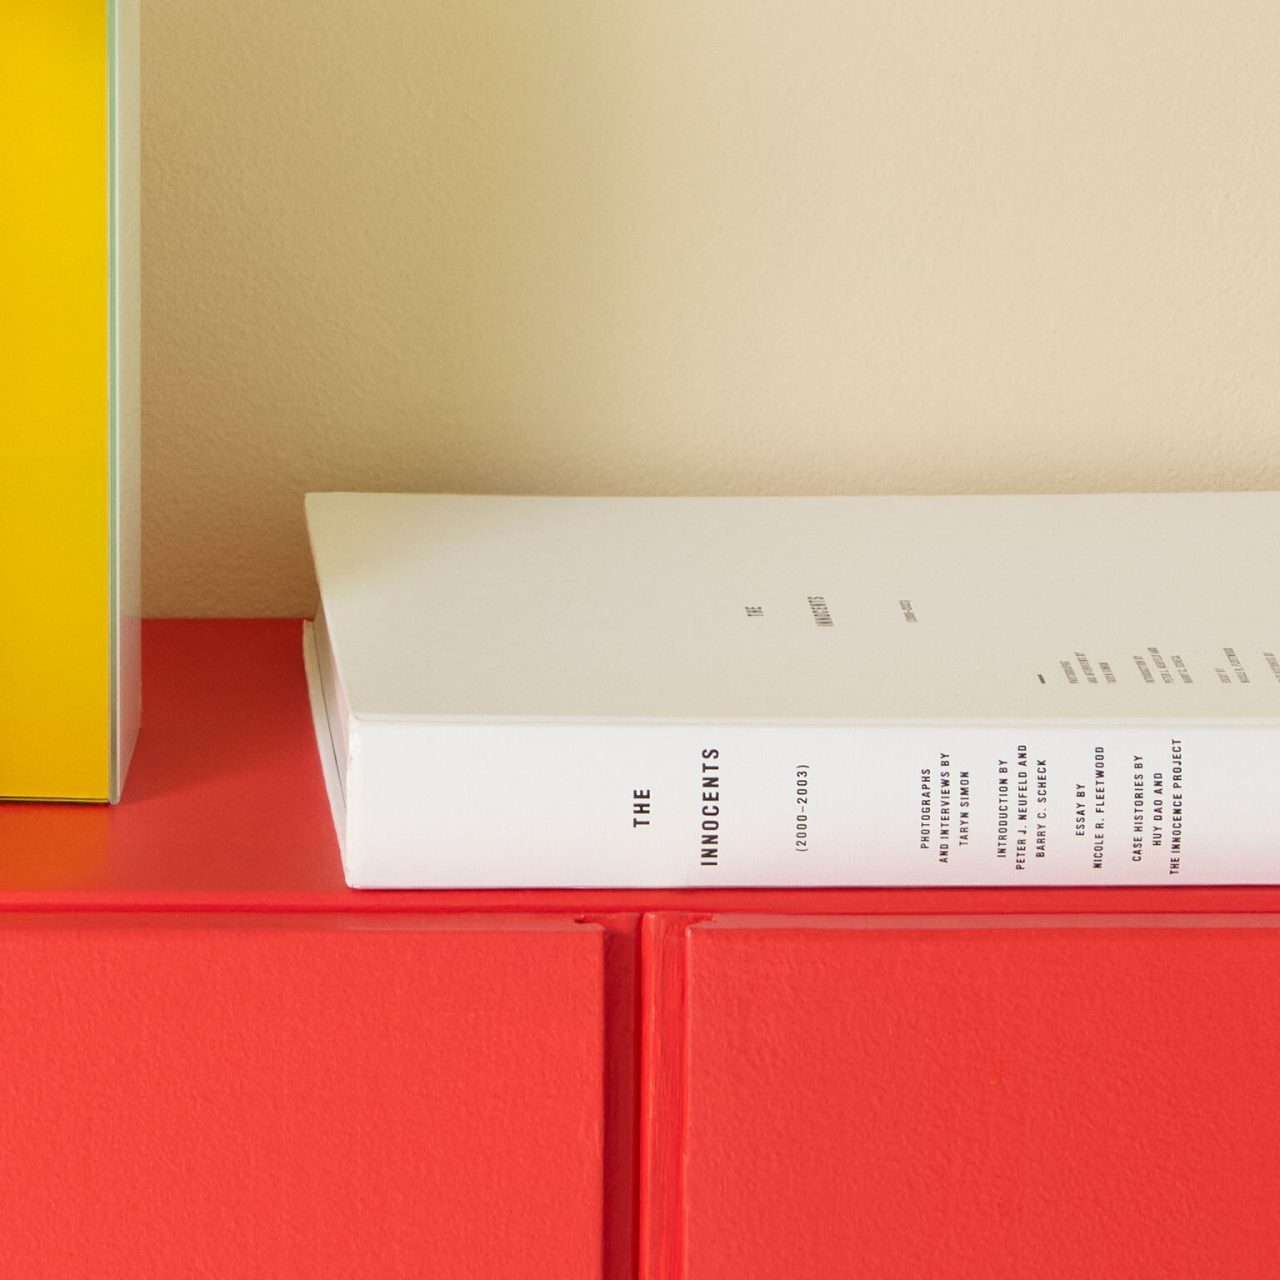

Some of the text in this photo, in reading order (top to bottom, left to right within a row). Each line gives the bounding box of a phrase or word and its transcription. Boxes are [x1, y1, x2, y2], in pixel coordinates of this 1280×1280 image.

[632, 789, 651, 829] THE
[700, 748, 720, 866] INNOCENTS
[920, 768, 931, 850] PHOTOGRAPHS
[938, 752, 951, 864] AND INTERVIEWS BY
[958, 771, 970, 847] TARYN SIMON
[996, 759, 1009, 858] INTRODUCTION BY
[1015, 744, 1028, 871] PETER J. NEUFELD AND
[1035, 759, 1048, 858] BARRY C. SCHECK
[1075, 783, 1086, 837] ESSAY BY
[1092, 746, 1105, 869] NICOLE R. FLEETWOOD
[1131, 755, 1144, 862] CASE HISTORIES BY
[1151, 772, 1164, 847] HUY DAO AND
[1169, 738, 1183, 875] THE INNOCENCE PROJECT
